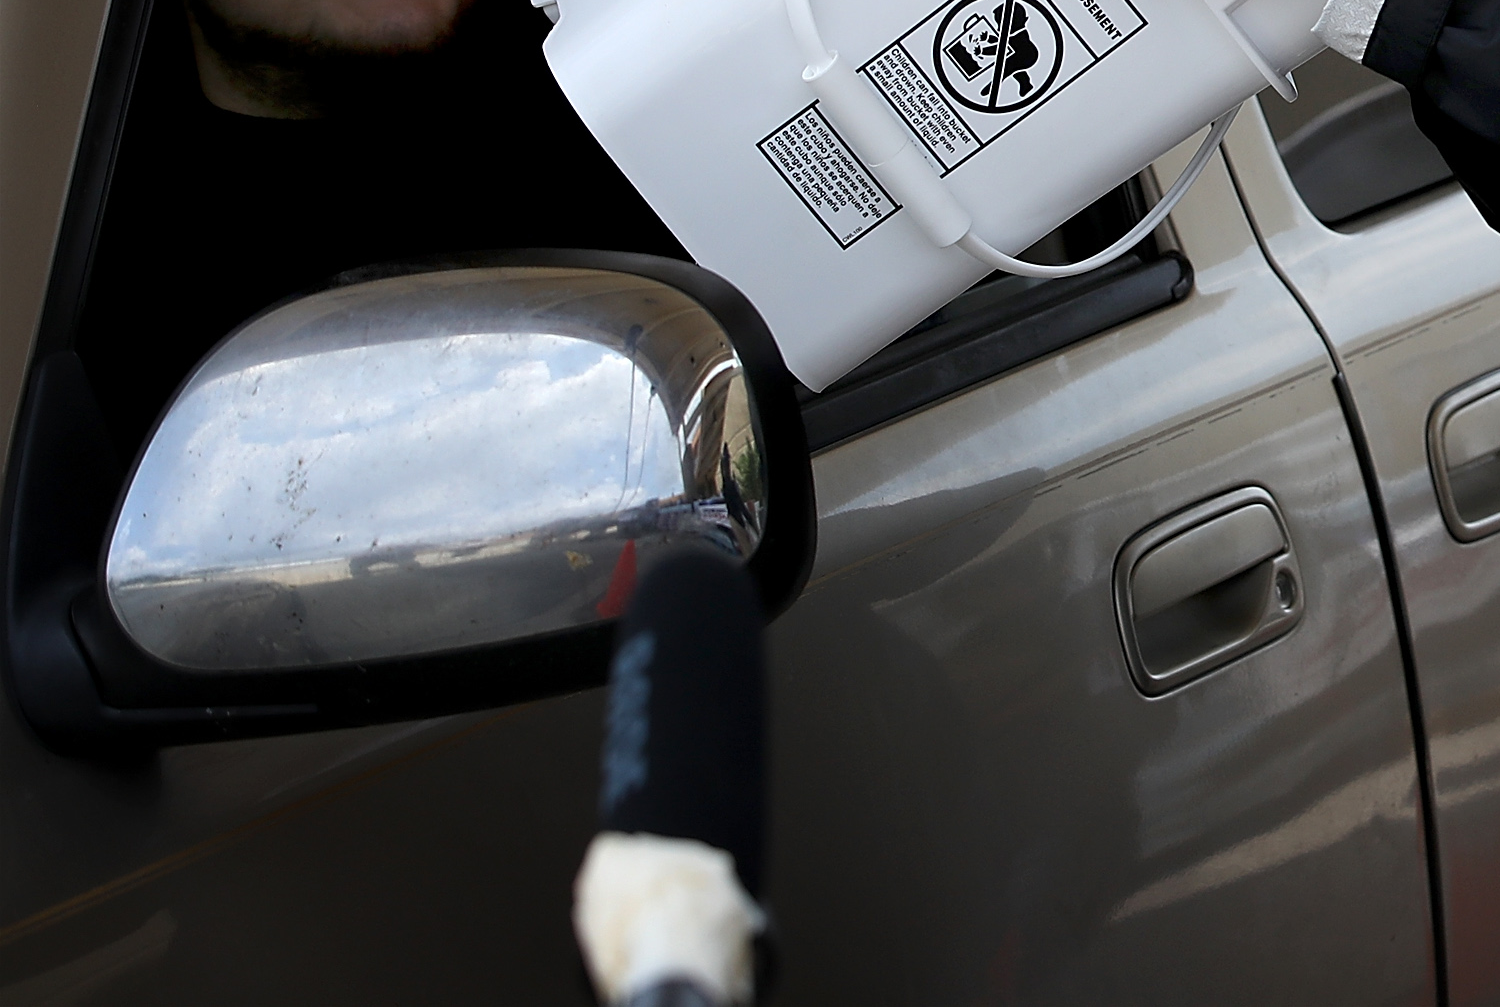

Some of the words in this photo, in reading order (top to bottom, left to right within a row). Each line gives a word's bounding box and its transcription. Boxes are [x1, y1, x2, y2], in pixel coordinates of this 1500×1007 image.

[873, 69, 895, 93] small
[889, 89, 917, 120] amount
[911, 116, 925, 128] of
[918, 123, 941, 150] liquid.
[875, 58, 895, 80] away
[890, 76, 910, 99] from
[905, 94, 931, 123] bucket
[925, 119, 942, 138] with
[938, 134, 957, 155] even
[882, 53, 900, 71] and
[894, 67, 917, 96] drown.
[914, 91, 935, 114] Keep
[930, 111, 958, 143] children
[890, 47, 919, 82] Children
[914, 78, 930, 96] can
[925, 91, 942, 108] fall
[935, 103, 952, 122] into
[947, 117, 973, 145] bucket
[765, 140, 797, 174] cantidad
[773, 134, 805, 171] contenga
[800, 167, 816, 185] una
[810, 181, 841, 214] pequeña
[781, 129, 798, 148] este
[793, 144, 814, 166] cubo
[808, 163, 835, 193] aunque
[788, 123, 805, 141] que
[799, 136, 814, 153] los
[809, 149, 831, 173] niños
[826, 170, 839, 183] se
[834, 176, 866, 214] acerquen
[796, 117, 814, 137] este
[808, 133, 829, 155] cubo
[829, 158, 860, 195] ahogarse.
[857, 190, 871, 205] No
[803, 110, 820, 129] Los
[815, 126, 837, 150] niños
[830, 146, 859, 176] pueden
[854, 173, 878, 199] caerse
